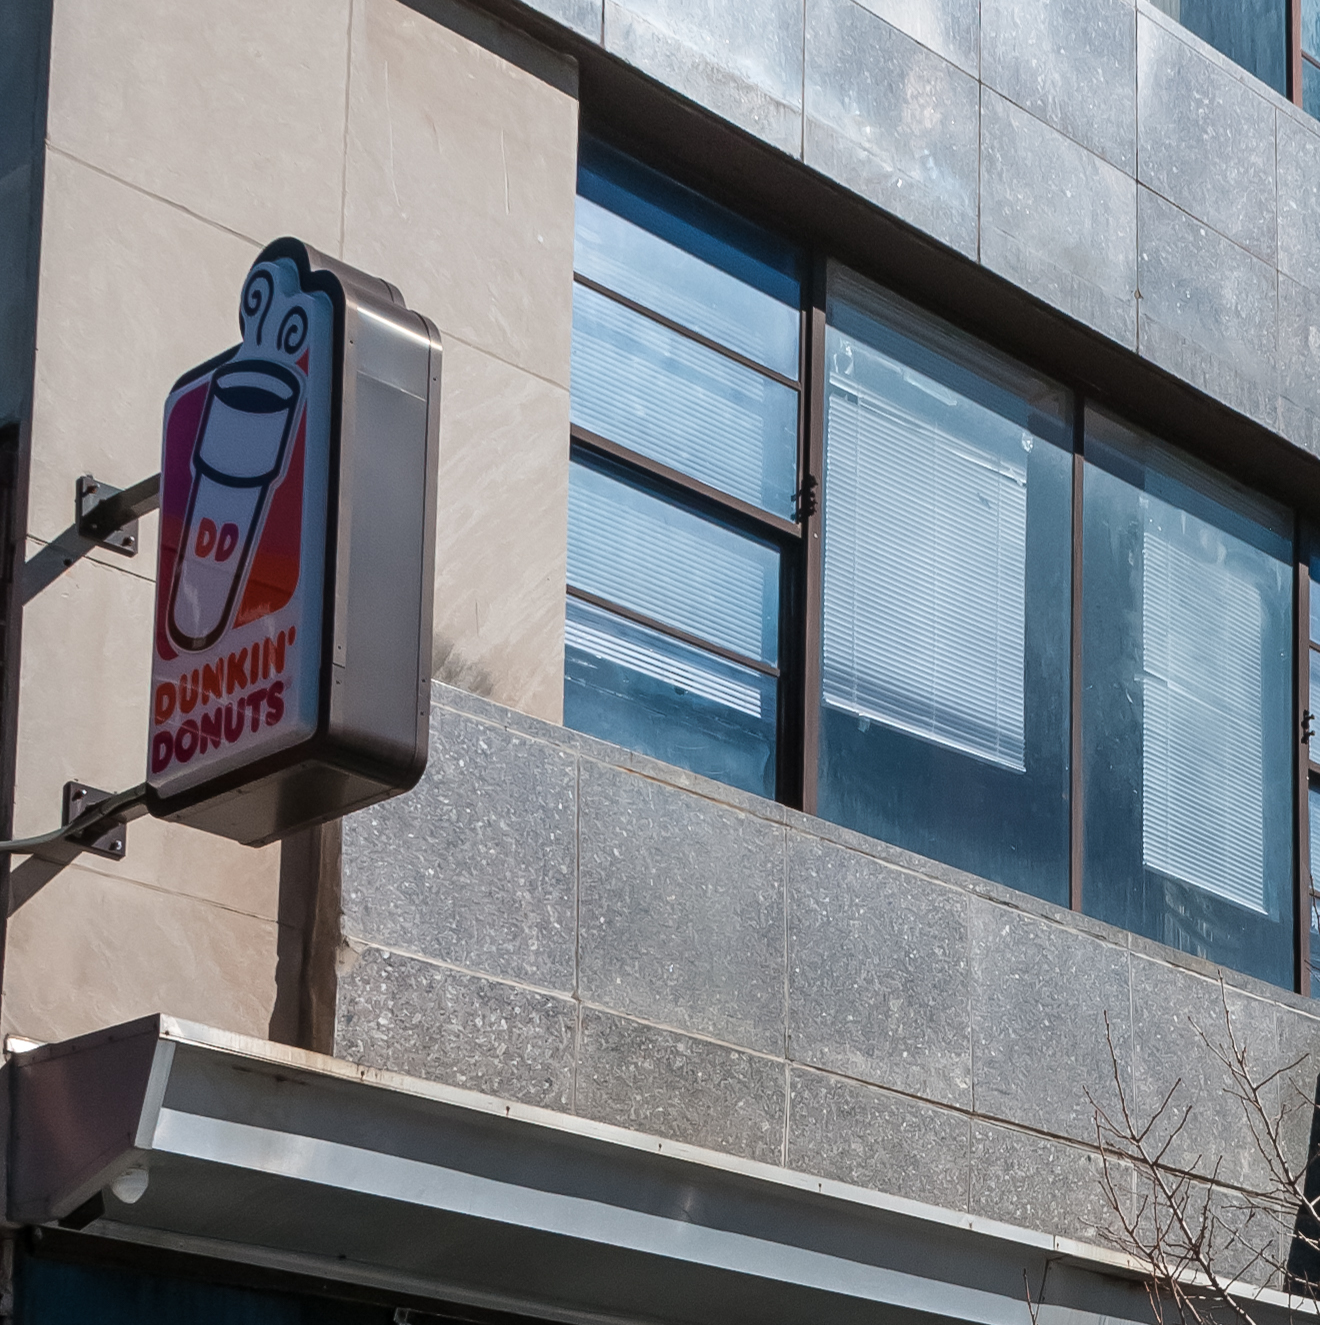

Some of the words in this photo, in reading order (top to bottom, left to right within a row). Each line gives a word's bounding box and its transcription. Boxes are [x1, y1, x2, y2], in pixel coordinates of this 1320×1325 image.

[194, 515, 240, 564] DD
[154, 625, 296, 726] DUNKIN'
[151, 680, 286, 774] DONUTS
